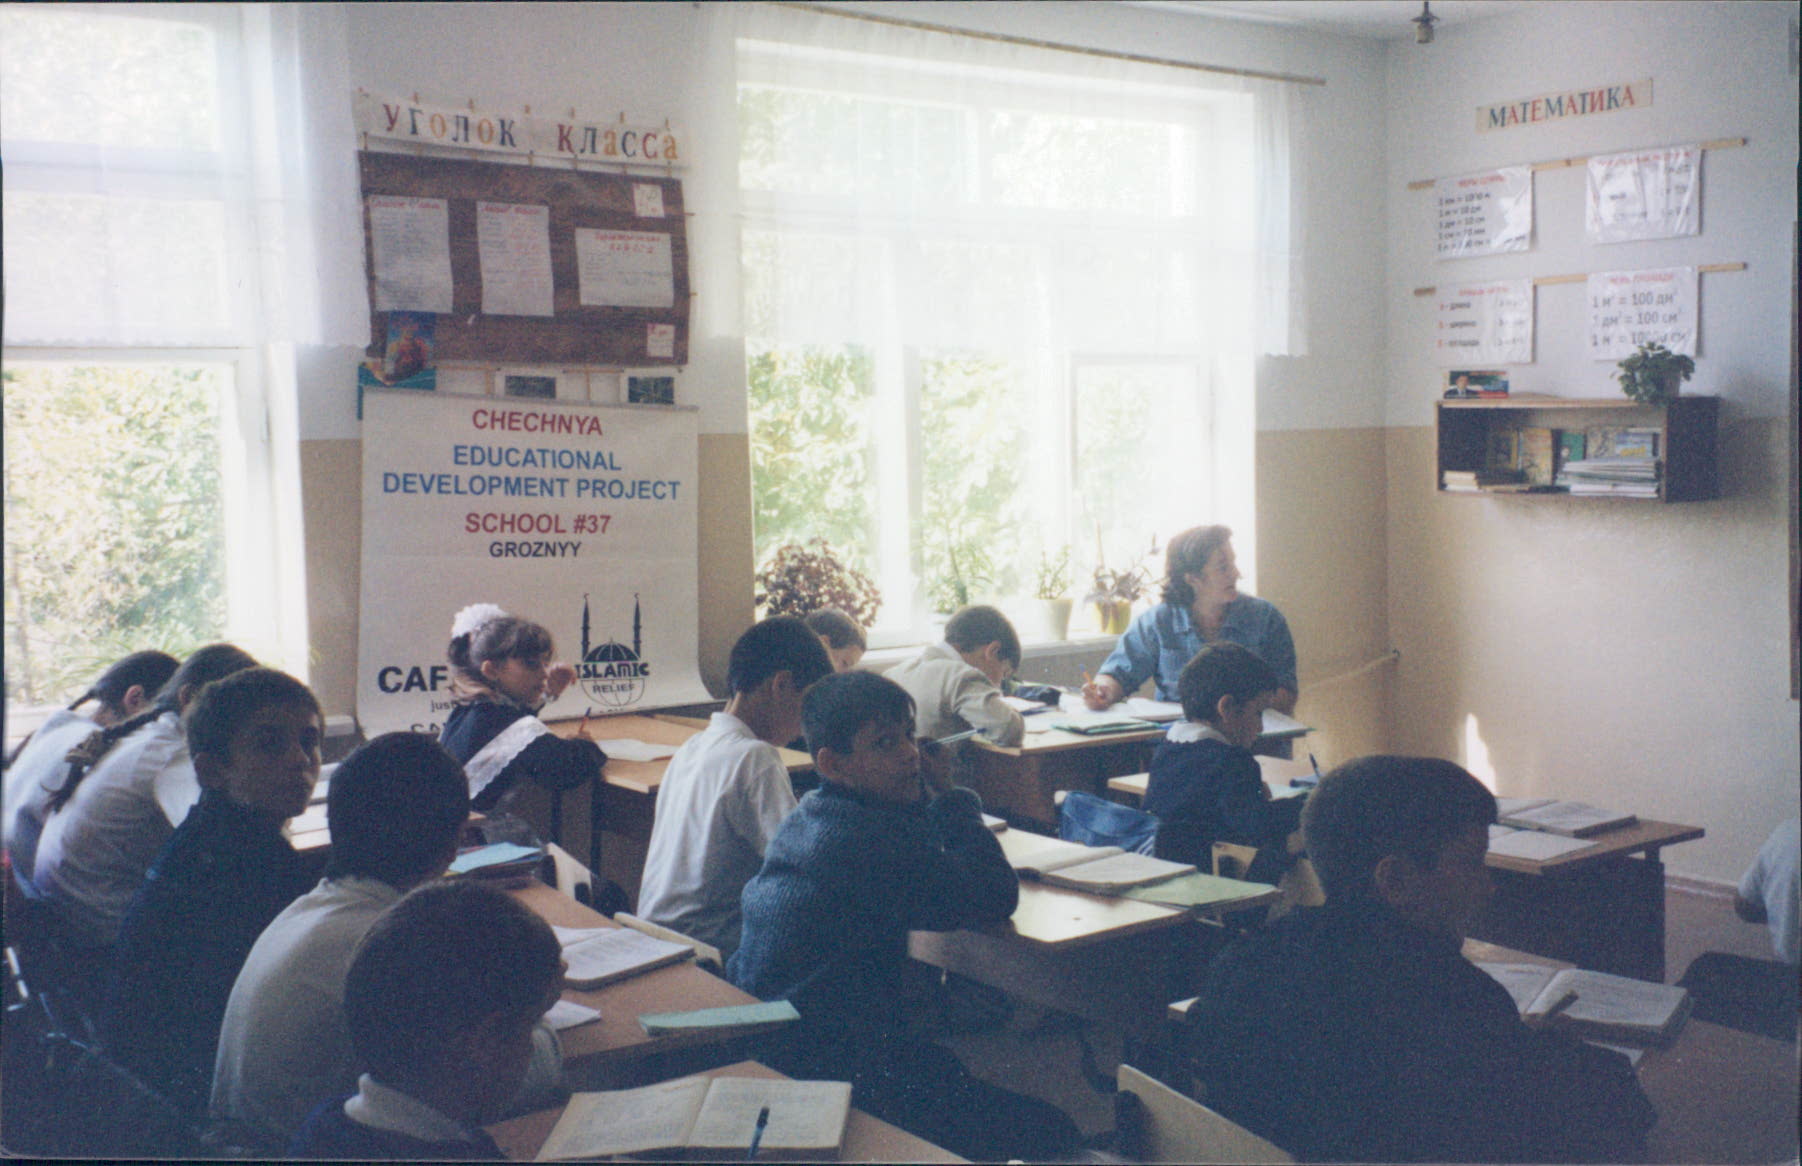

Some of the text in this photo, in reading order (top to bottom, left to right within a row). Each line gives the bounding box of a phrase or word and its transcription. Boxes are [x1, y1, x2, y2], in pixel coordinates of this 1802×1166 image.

[1488, 85, 1635, 128] МАТЕМАТИКА
[1632, 291, 1653, 306] 100
[1637, 311, 1659, 325] 100
[472, 409, 603, 436] CHECHNYA
[453, 445, 622, 472] EDUCATIONAL
[383, 472, 681, 501] DEVELOPMENT PROJECT
[464, 513, 611, 534] SCHOOL #37
[489, 542, 582, 558] GROZNYY
[378, 666, 448, 693] CAF
[592, 683, 635, 694] RELIEF
